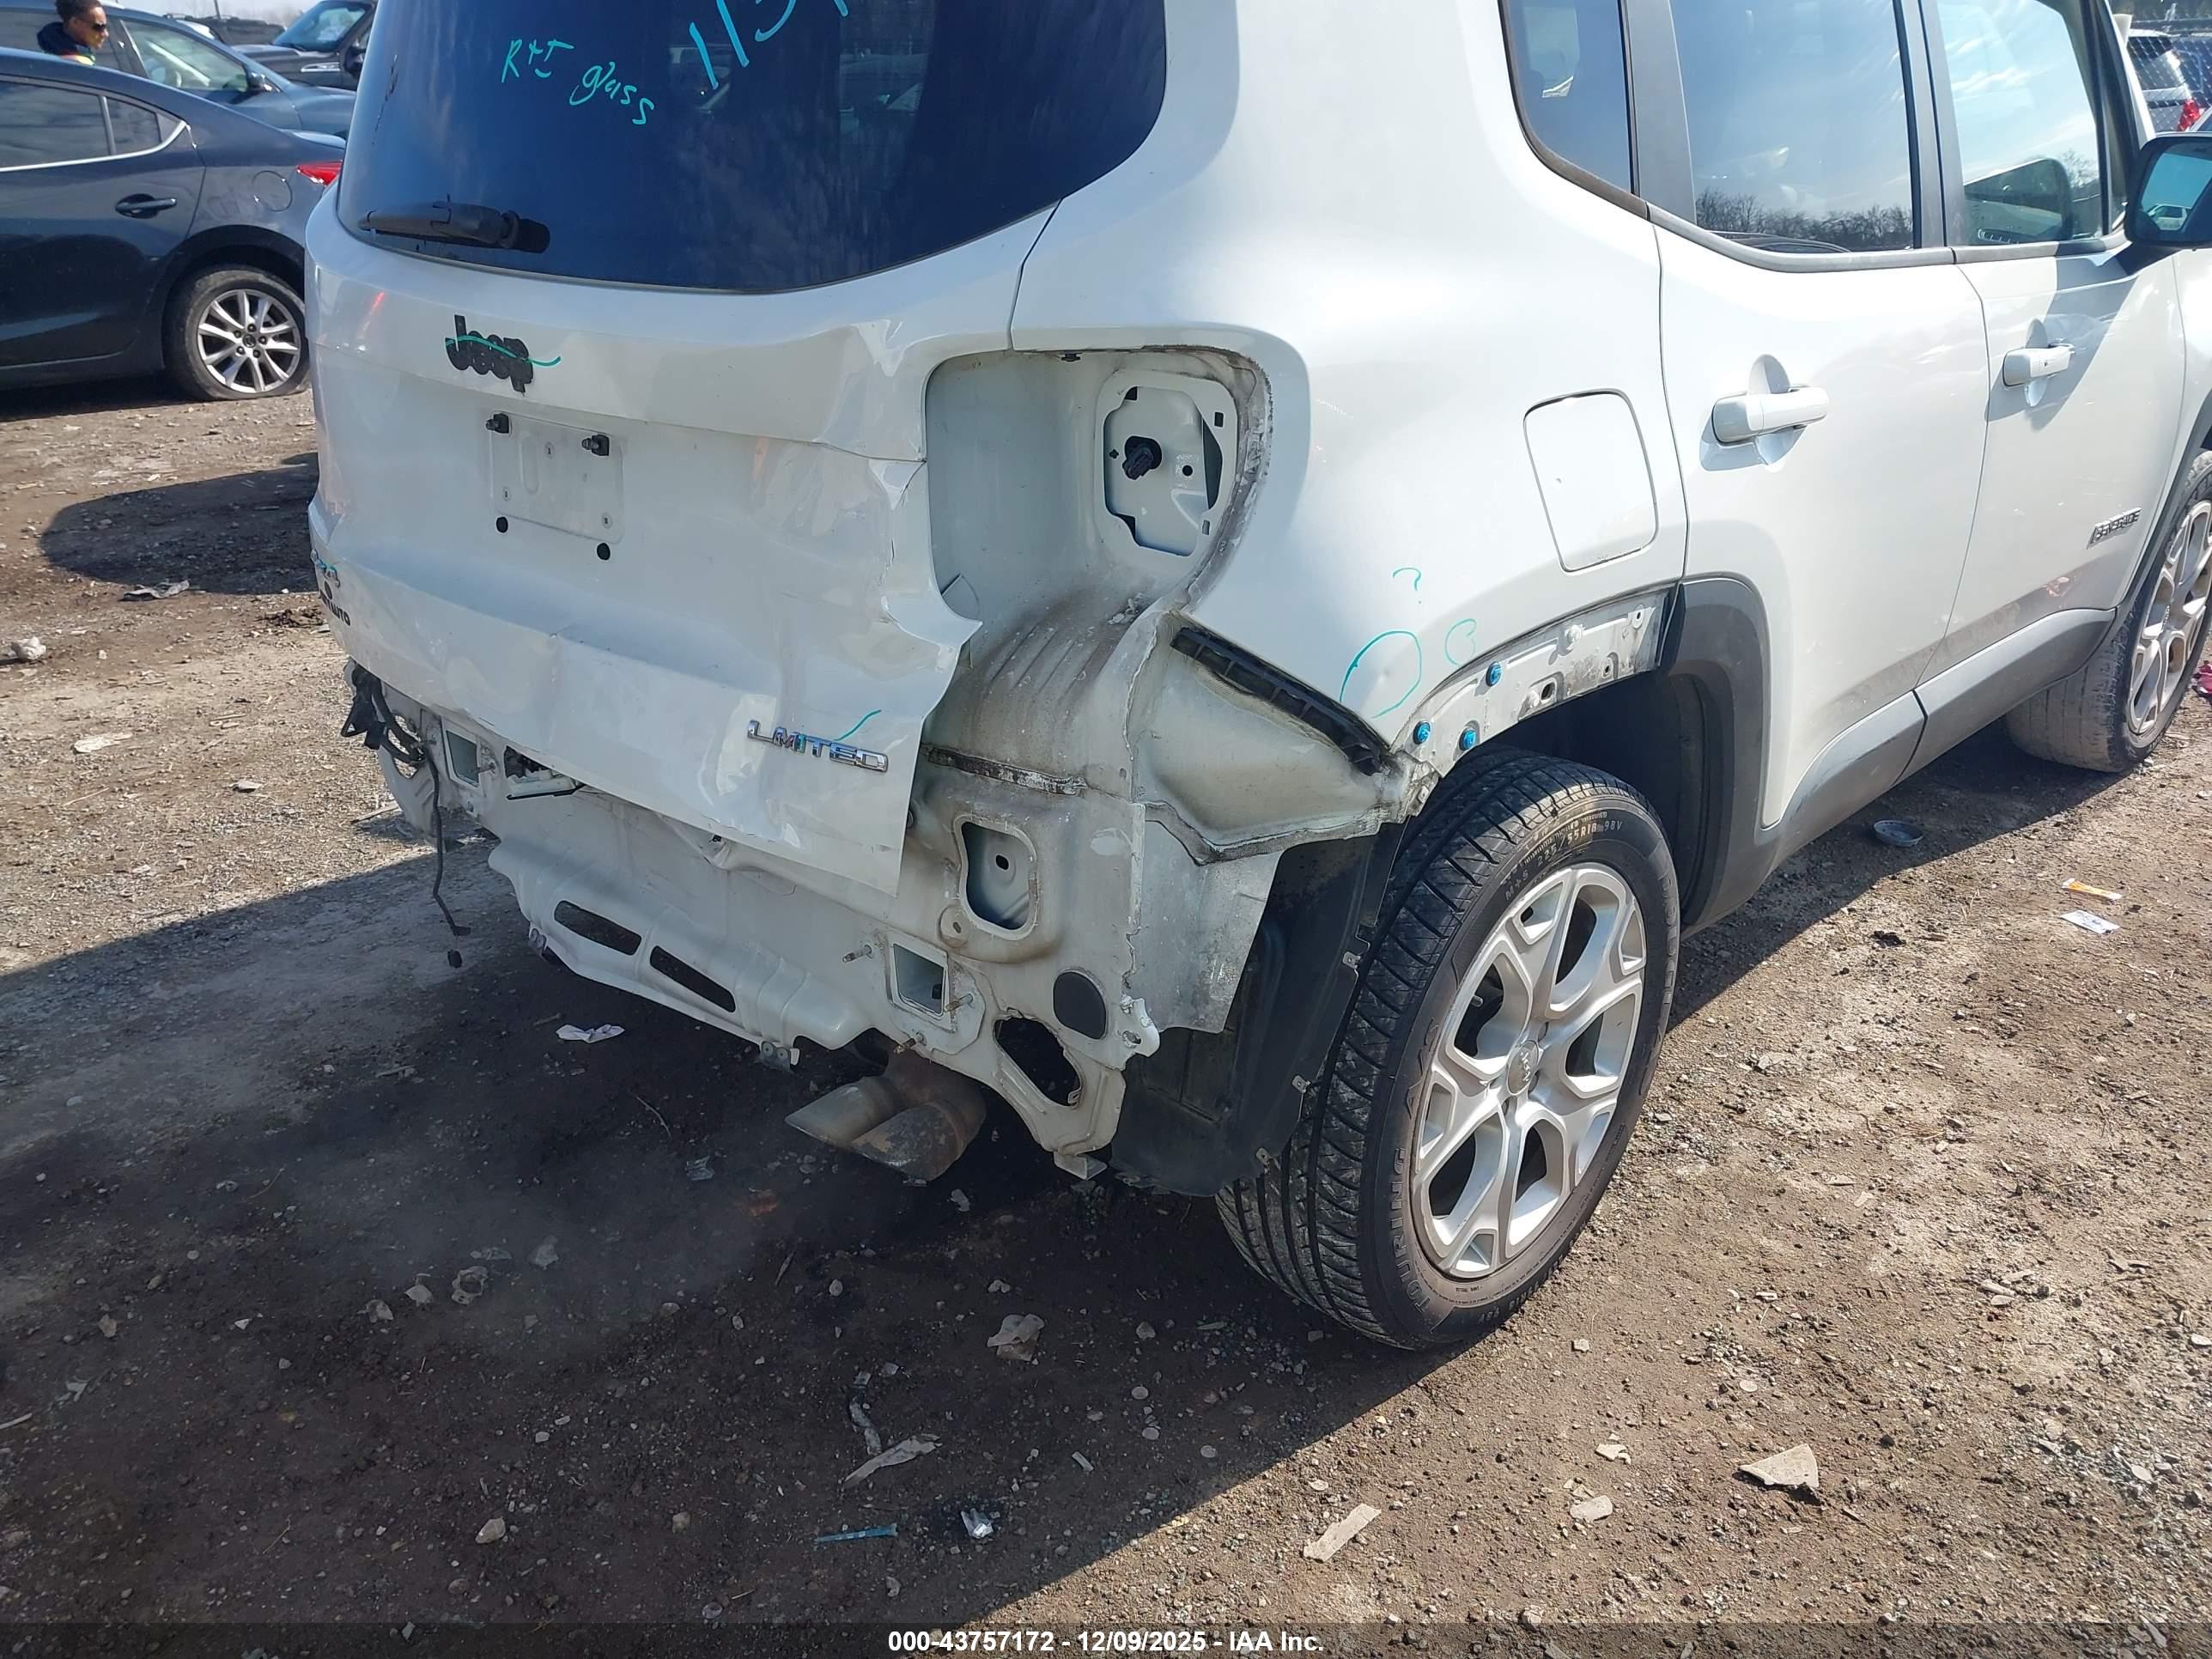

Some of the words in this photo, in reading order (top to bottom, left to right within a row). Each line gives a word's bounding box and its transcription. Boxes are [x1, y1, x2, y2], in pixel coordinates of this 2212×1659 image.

[569, 61, 655, 125] glass
[445, 314, 534, 393] Jeep
[1390, 1147, 1431, 1314] TOURING
